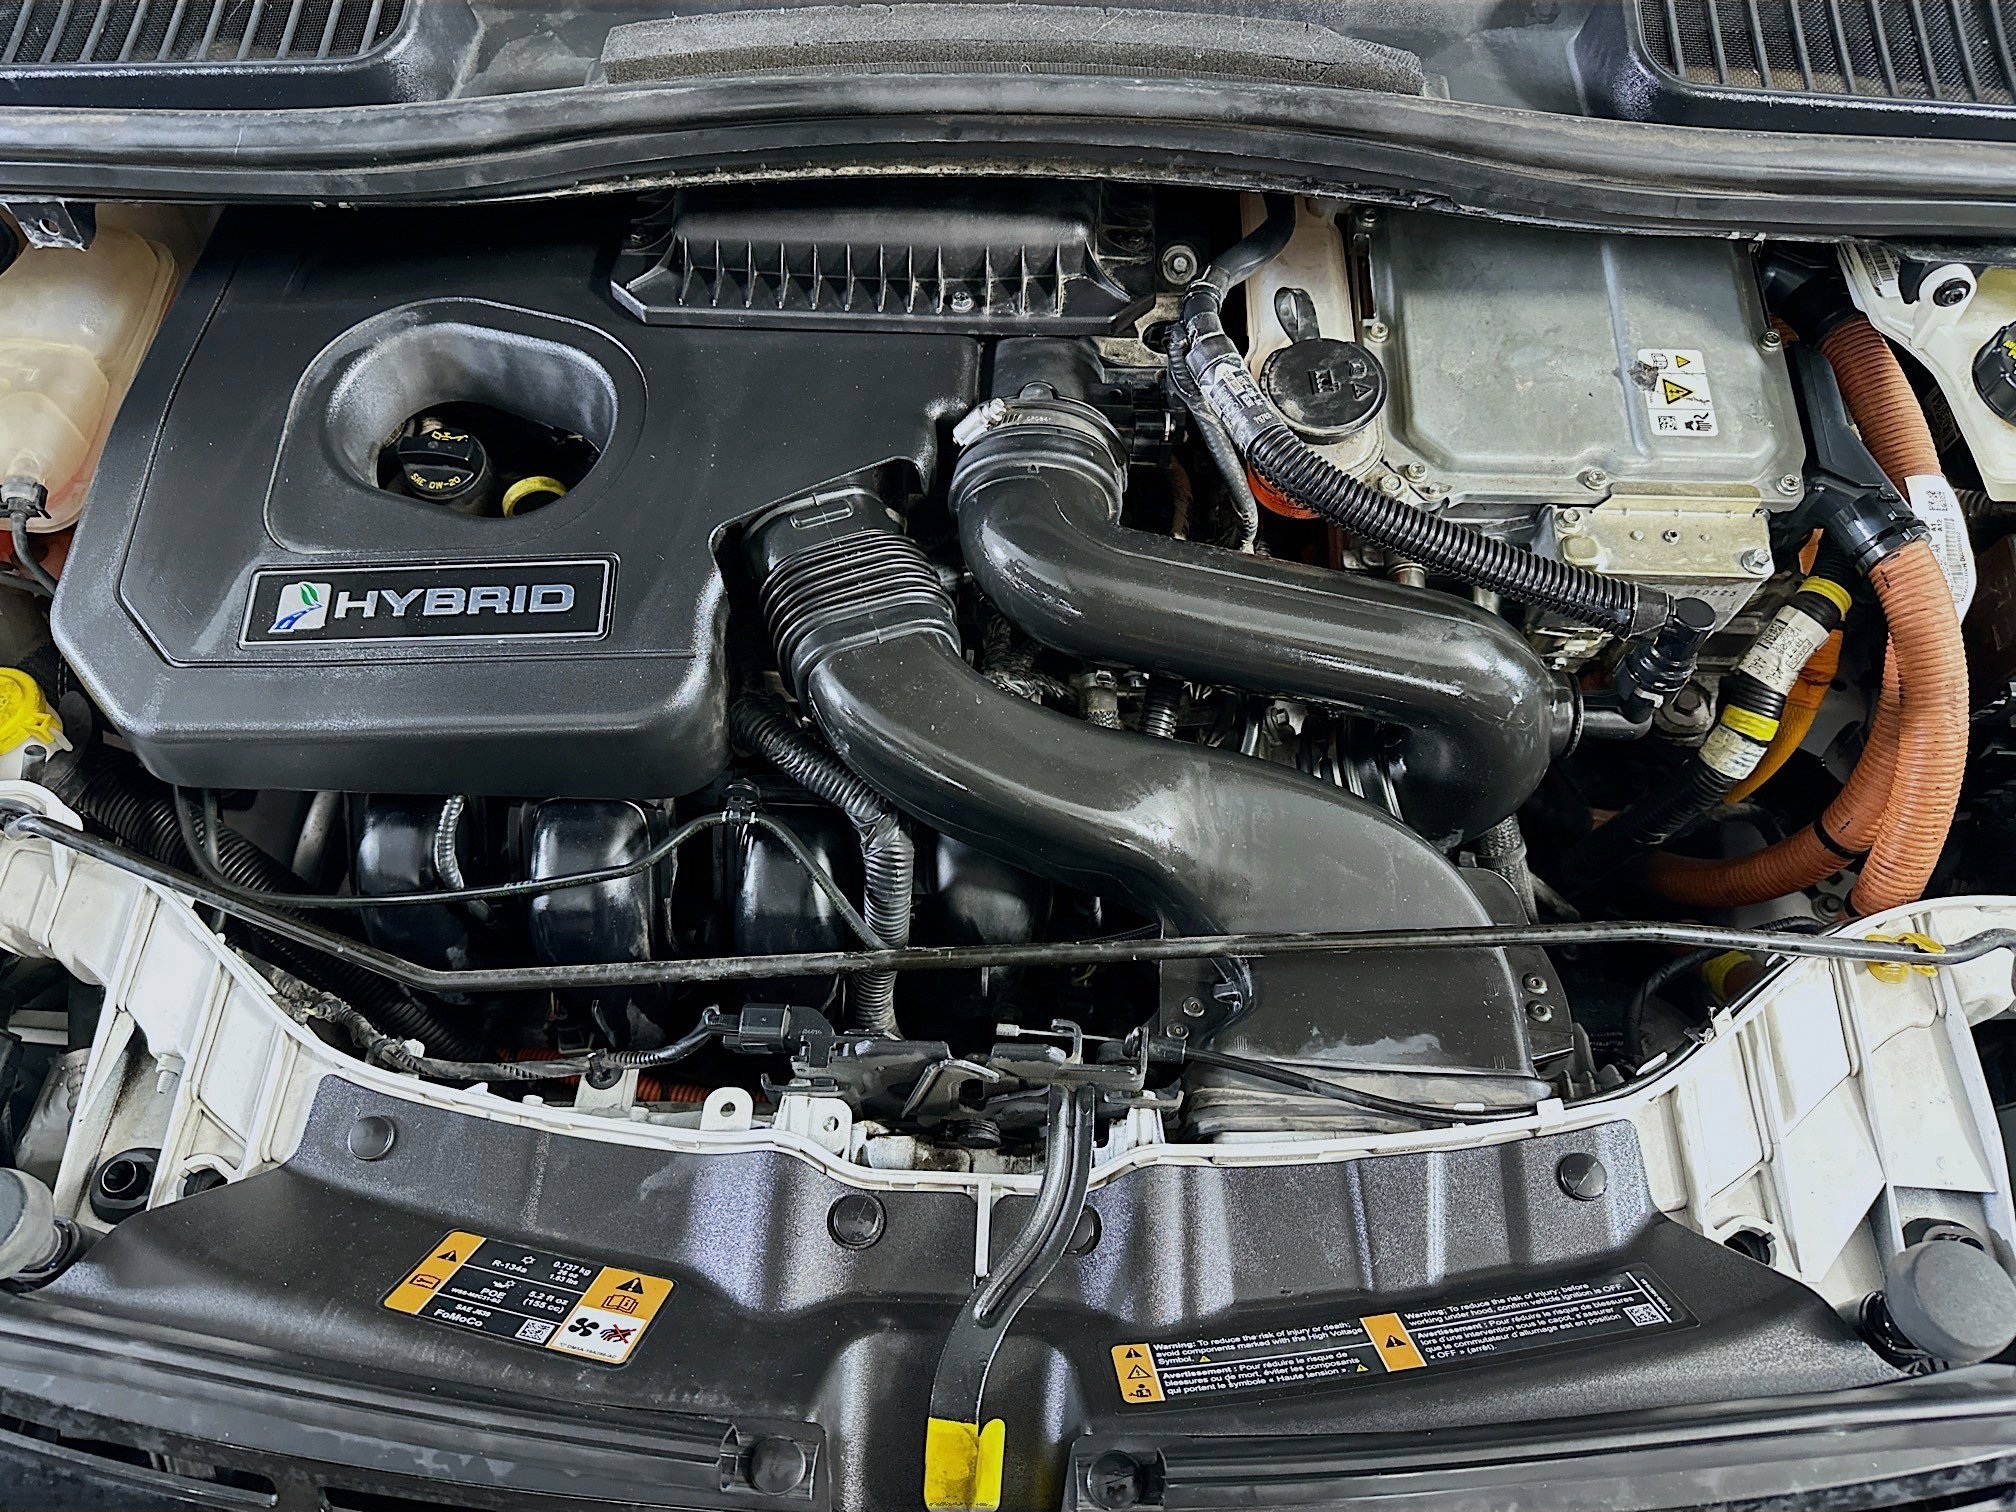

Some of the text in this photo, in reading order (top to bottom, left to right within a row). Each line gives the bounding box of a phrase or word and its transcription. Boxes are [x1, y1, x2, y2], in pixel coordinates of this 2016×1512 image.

[410, 473, 427, 486] SAE
[333, 584, 575, 620] HYBRID
[492, 1259, 527, 1273] R-134a
[553, 1261, 592, 1276] 0.737 kg
[480, 1288, 506, 1299] POE
[528, 1291, 545, 1299] 5.2
[1461, 1300, 1490, 1310] reduce
[1507, 1294, 1523, 1302] risk
[1561, 1283, 1589, 1292] before
[455, 1304, 473, 1312] SAE
[523, 1298, 564, 1314] (155 cc)
[1409, 1316, 1443, 1326] working
[1444, 1311, 1470, 1320] under
[1498, 1301, 1529, 1311] confirm
[1530, 1296, 1560, 1305] vehicle
[1562, 1290, 1593, 1300] ignition
[1602, 1284, 1625, 1292] OFF.
[434, 1309, 483, 1327] FoMoCo
[1418, 1324, 1483, 1339] Avertissement
[1488, 1318, 1510, 1326] Pour
[1512, 1313, 1542, 1323] réduire
[1553, 1307, 1579, 1315] risque
[1592, 1295, 1634, 1308] blessures
[1420, 1337, 1438, 1346] lors
[1438, 1334, 1463, 1342] d'une
[1464, 1324, 1514, 1338] intervention
[1576, 1307, 1614, 1318] s'assurer
[1454, 1333, 1510, 1348] commutateur
[1511, 1325, 1558, 1338] d'allumage
[1560, 1322, 1574, 1330] est
[1588, 1314, 1622, 1326] position
[1156, 1328, 1363, 1357] avoid components marked with the High Voltage
[1210, 1337, 1241, 1345] reduce
[1286, 1327, 1310, 1336] injury
[1158, 1356, 1195, 1365] Symbol.
[1437, 1350, 1456, 1358] OFF
[1163, 1366, 1233, 1379] Avertissement
[1239, 1363, 1260, 1372] Pour
[1263, 1359, 1294, 1368] réduire
[1306, 1353, 1334, 1363] risque
[1164, 1377, 1208, 1386] blessures
[1225, 1372, 1236, 1381] de
[1264, 1367, 1288, 1376] éviter
[1290, 1364, 1304, 1372] les
[1306, 1358, 1360, 1370] composants
[1167, 1387, 1181, 1395] qui
[1184, 1384, 1216, 1394] portent
[1228, 1378, 1266, 1389] symbole
[1276, 1373, 1304, 1382] Haute
[1306, 1368, 1339, 1378] tension
